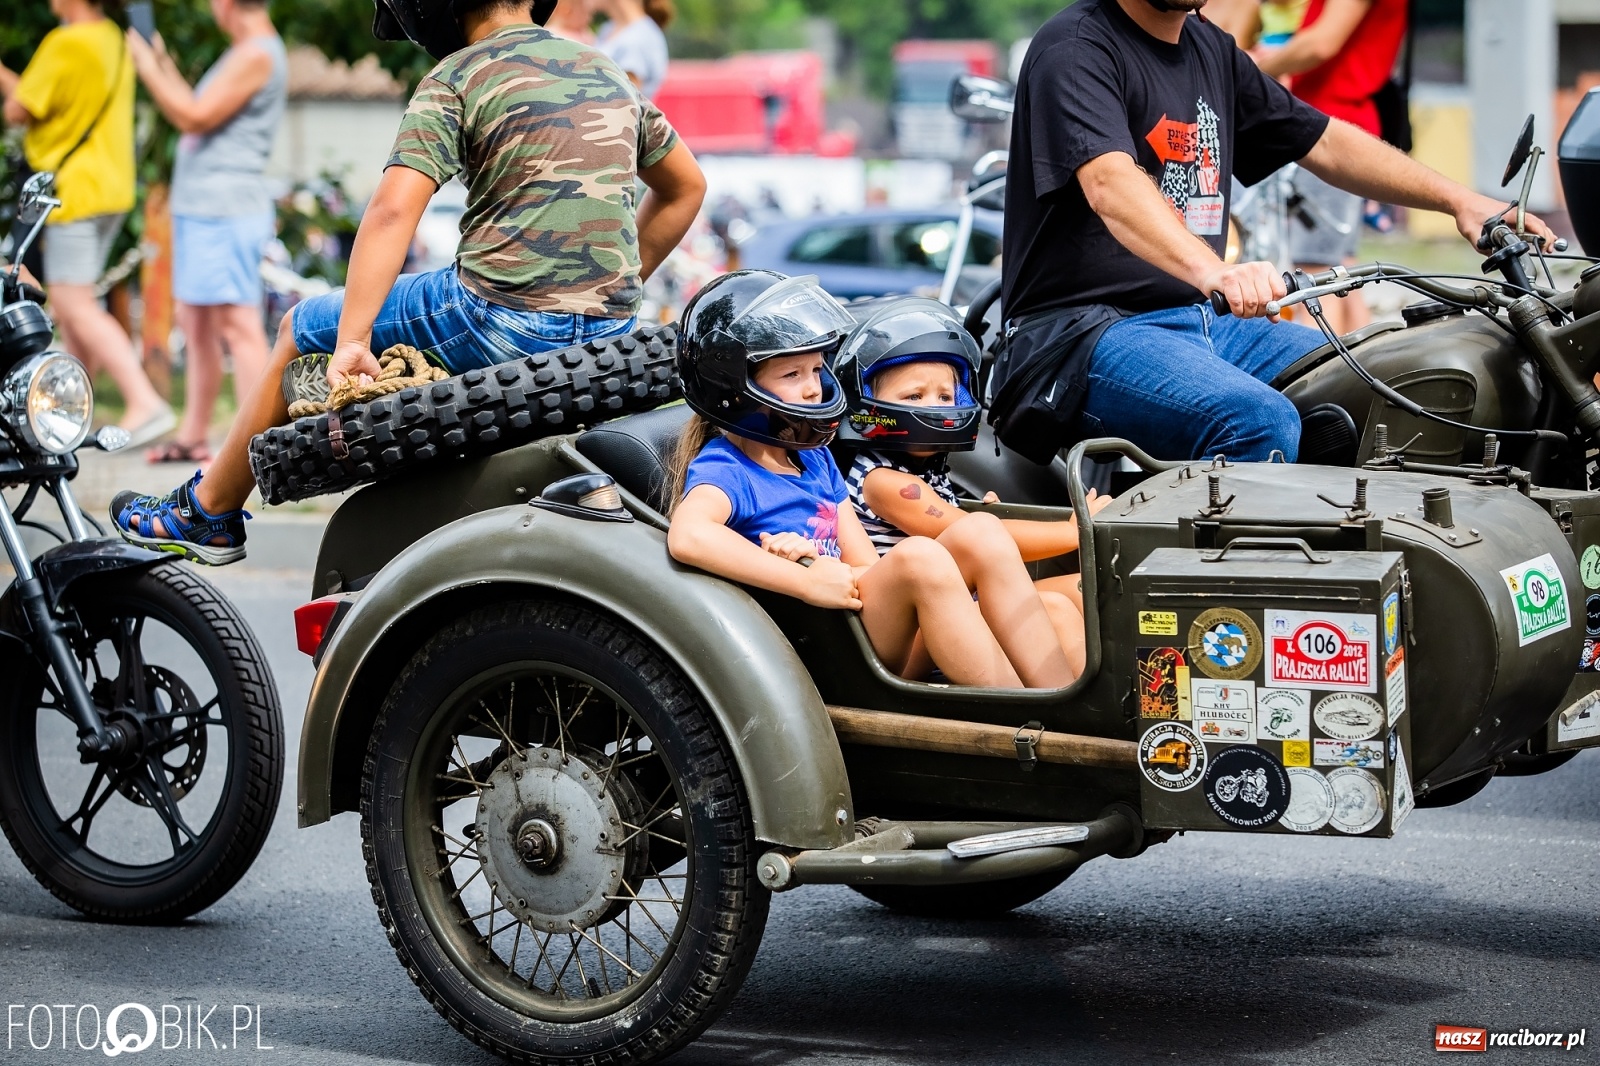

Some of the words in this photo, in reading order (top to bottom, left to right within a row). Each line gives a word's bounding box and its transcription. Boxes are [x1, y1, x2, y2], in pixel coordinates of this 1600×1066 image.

[1531, 580, 1545, 602] 98
[1549, 584, 1561, 598] 2013
[1547, 597, 1566, 625] RALLYE
[1286, 641, 1296, 653] X.
[1343, 645, 1363, 658] 2012
[1304, 633, 1336, 655] 106
[1275, 653, 1328, 681] PRAJZSKÁ
[1329, 657, 1367, 682] RALLYE
[1200, 710, 1247, 719] HLUBOČEC
[1142, 725, 1174, 751] OPERACJA
[1176, 726, 1205, 760] POŁUDNIE
[1146, 768, 1197, 788] BIELSKO-BIAŁA
[1263, 809, 1278, 822] 2009
